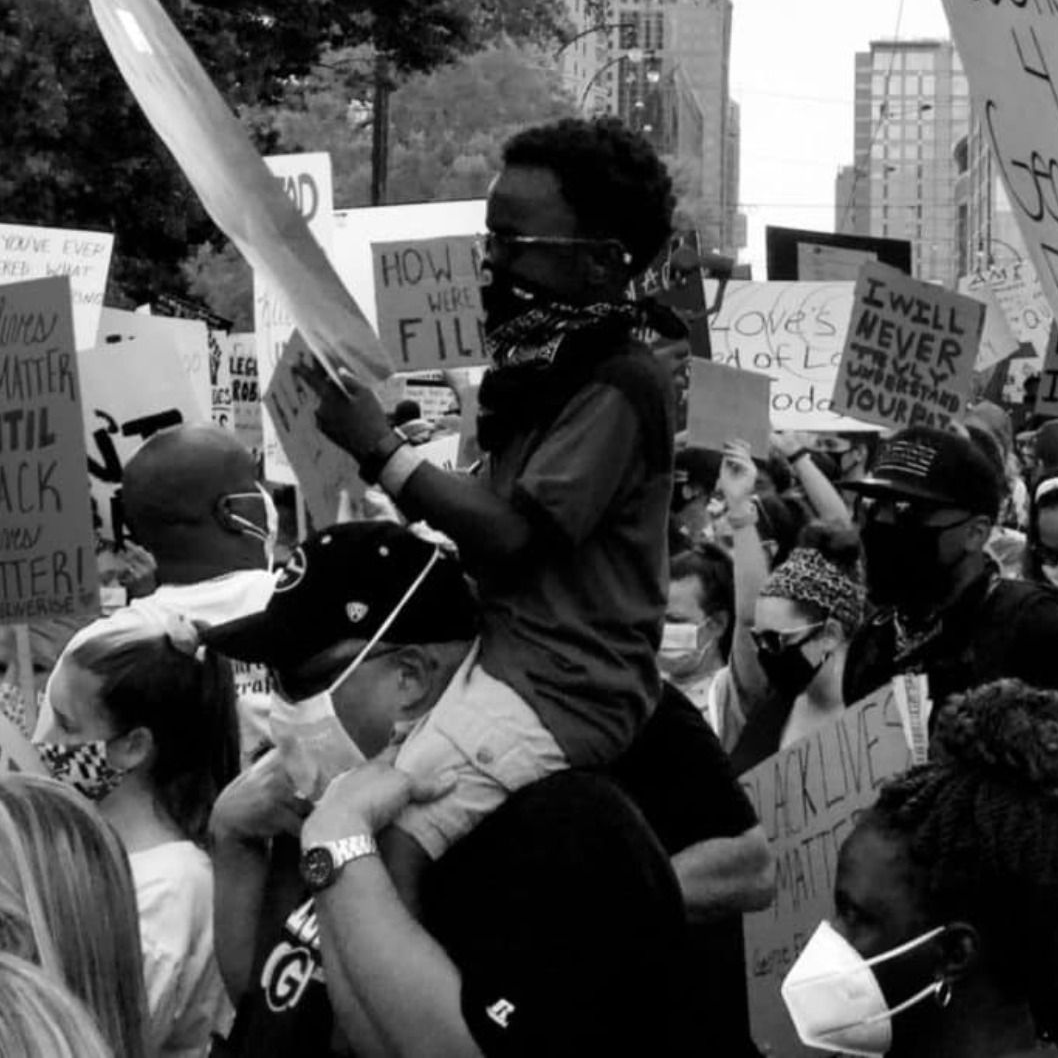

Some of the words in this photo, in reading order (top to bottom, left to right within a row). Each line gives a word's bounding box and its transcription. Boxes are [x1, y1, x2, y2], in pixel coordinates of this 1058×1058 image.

[381, 244, 451, 288] HOW
[426, 286, 476, 312] WERE
[863, 277, 886, 309] I
[889, 290, 964, 335] WILL
[855, 309, 962, 375] NEVER
[845, 380, 908, 424] YOUR
[0, 406, 56, 452] TIL
